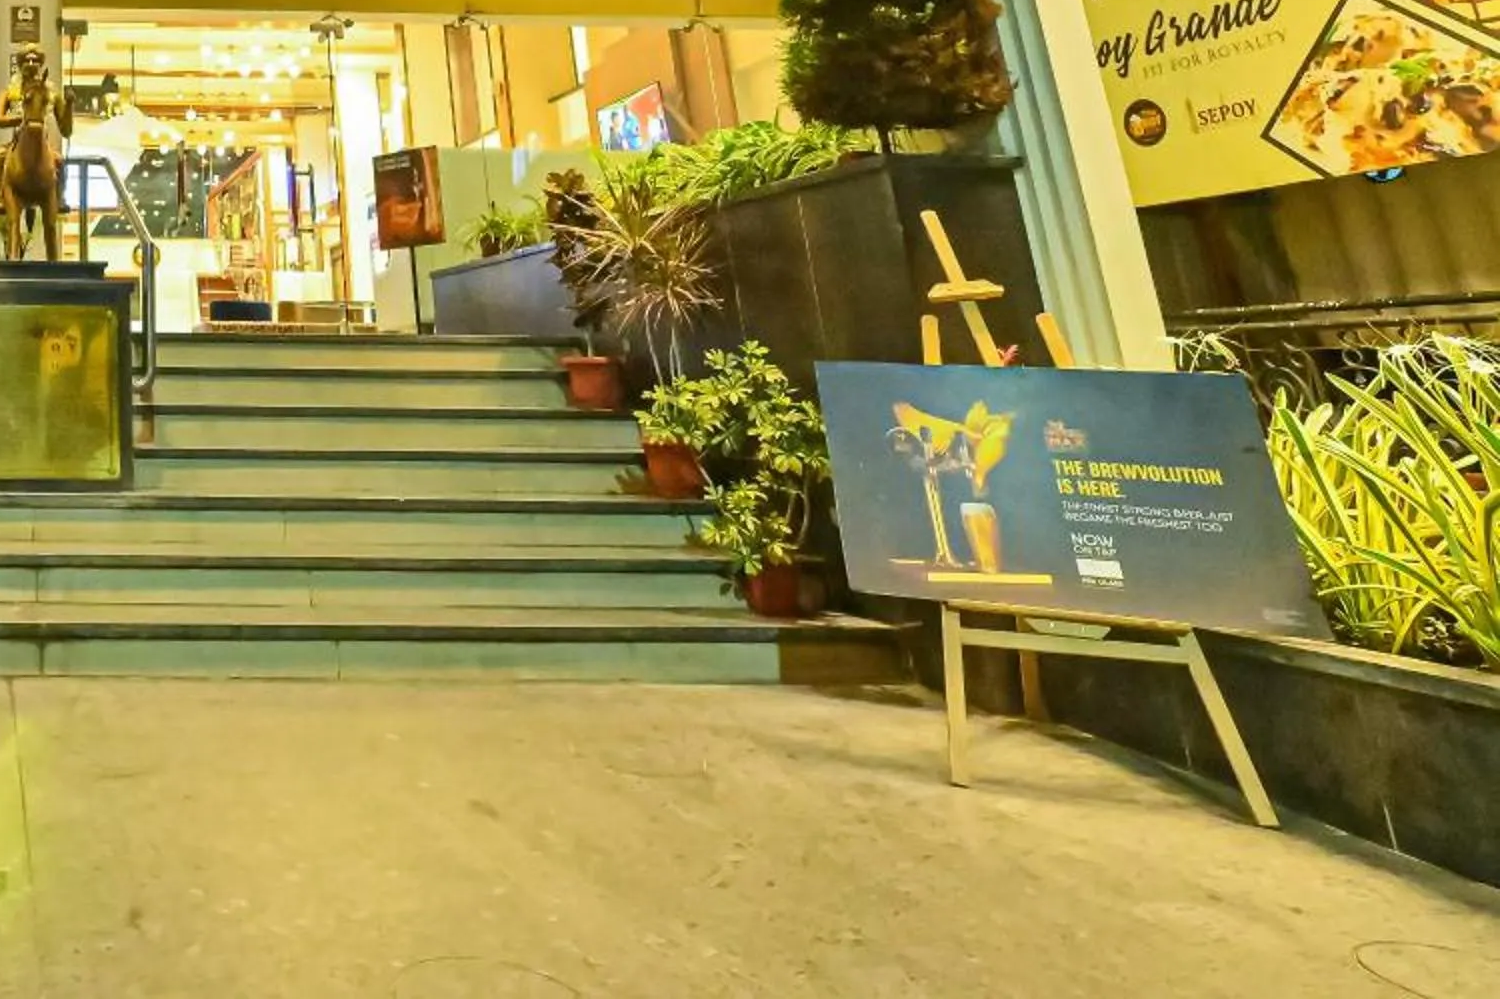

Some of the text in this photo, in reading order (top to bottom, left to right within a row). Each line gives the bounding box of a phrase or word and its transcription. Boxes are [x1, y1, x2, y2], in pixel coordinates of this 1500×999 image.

[1170, 52, 1202, 72] FOR
[1207, 28, 1287, 63] ROYALTY
[1197, 98, 1256, 126] SEPOY
[1052, 458, 1225, 486] THE BREWVOLUTION
[1056, 478, 1075, 494] IS
[1071, 532, 1113, 547] NOW
